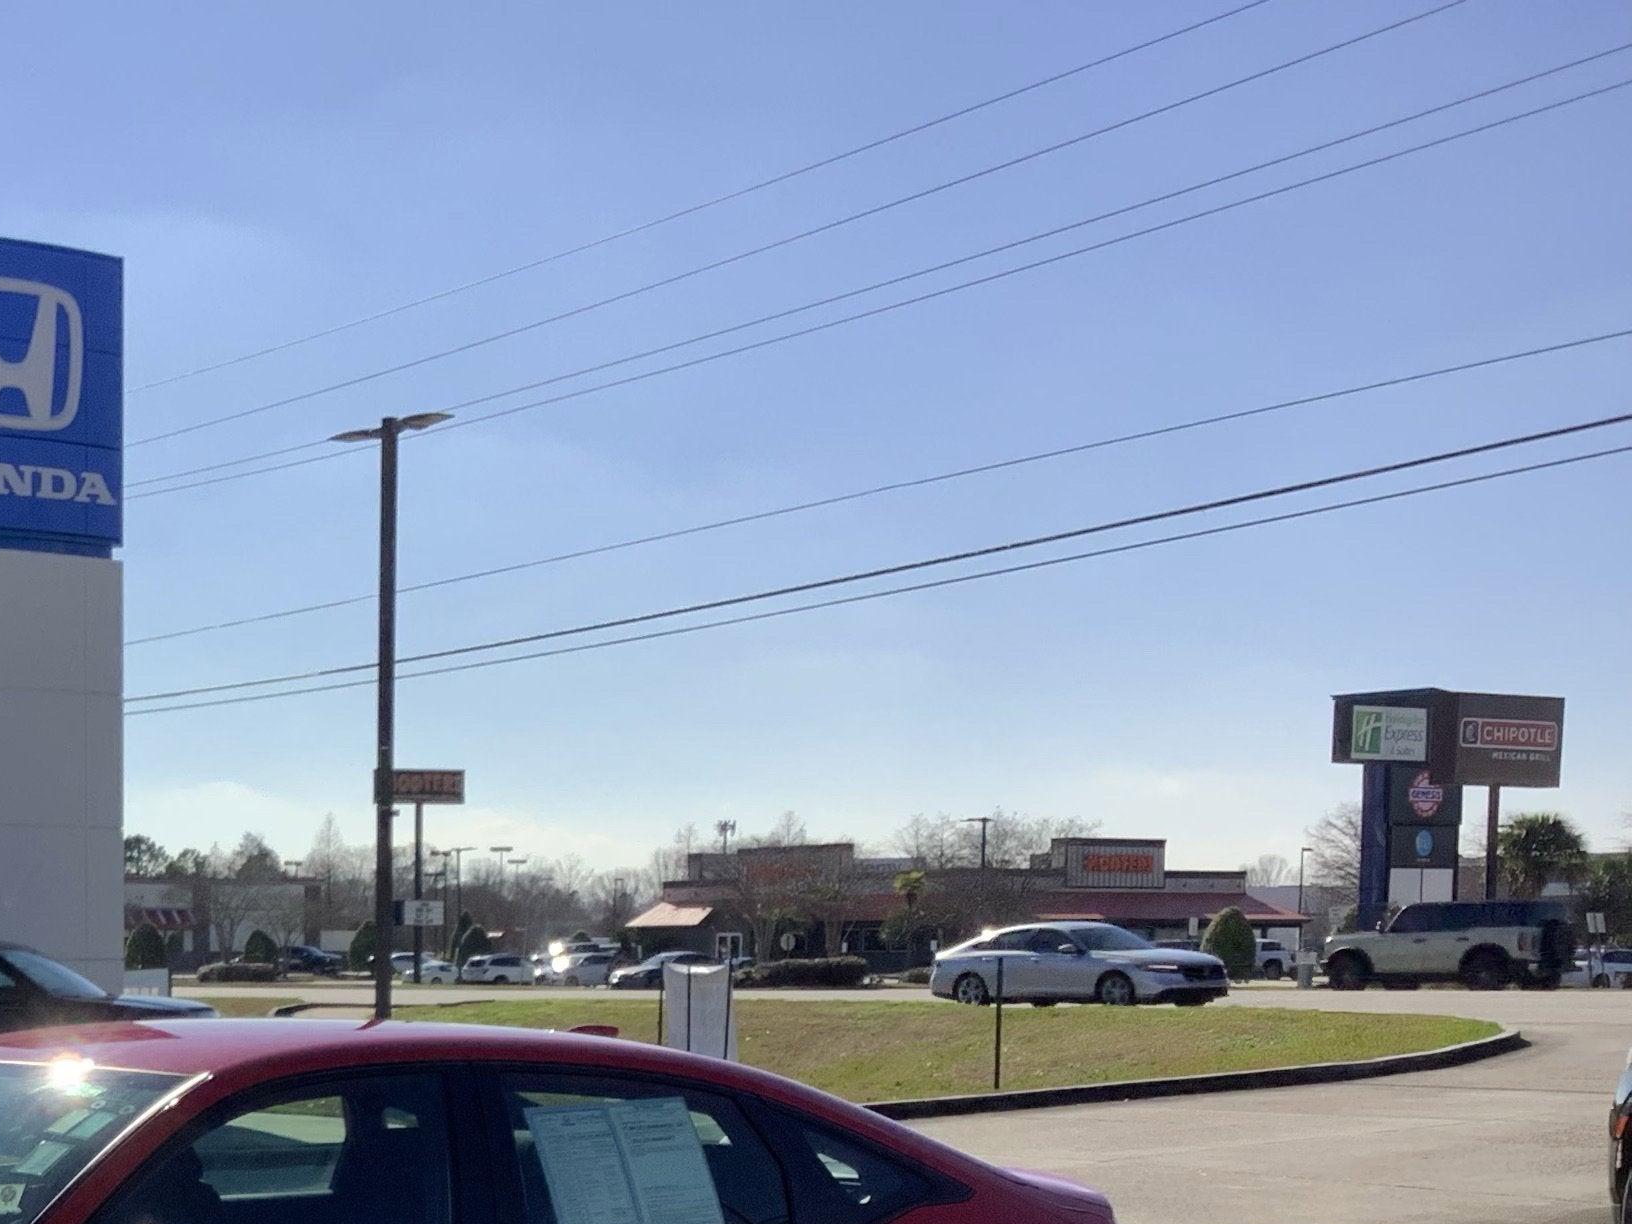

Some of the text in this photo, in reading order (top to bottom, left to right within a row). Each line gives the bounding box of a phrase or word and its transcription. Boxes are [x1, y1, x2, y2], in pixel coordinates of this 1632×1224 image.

[1385, 725, 1425, 743] Express
[1483, 726, 1553, 744] CHIPOTLE
[1491, 751, 1551, 762] MEXICAN GRILL
